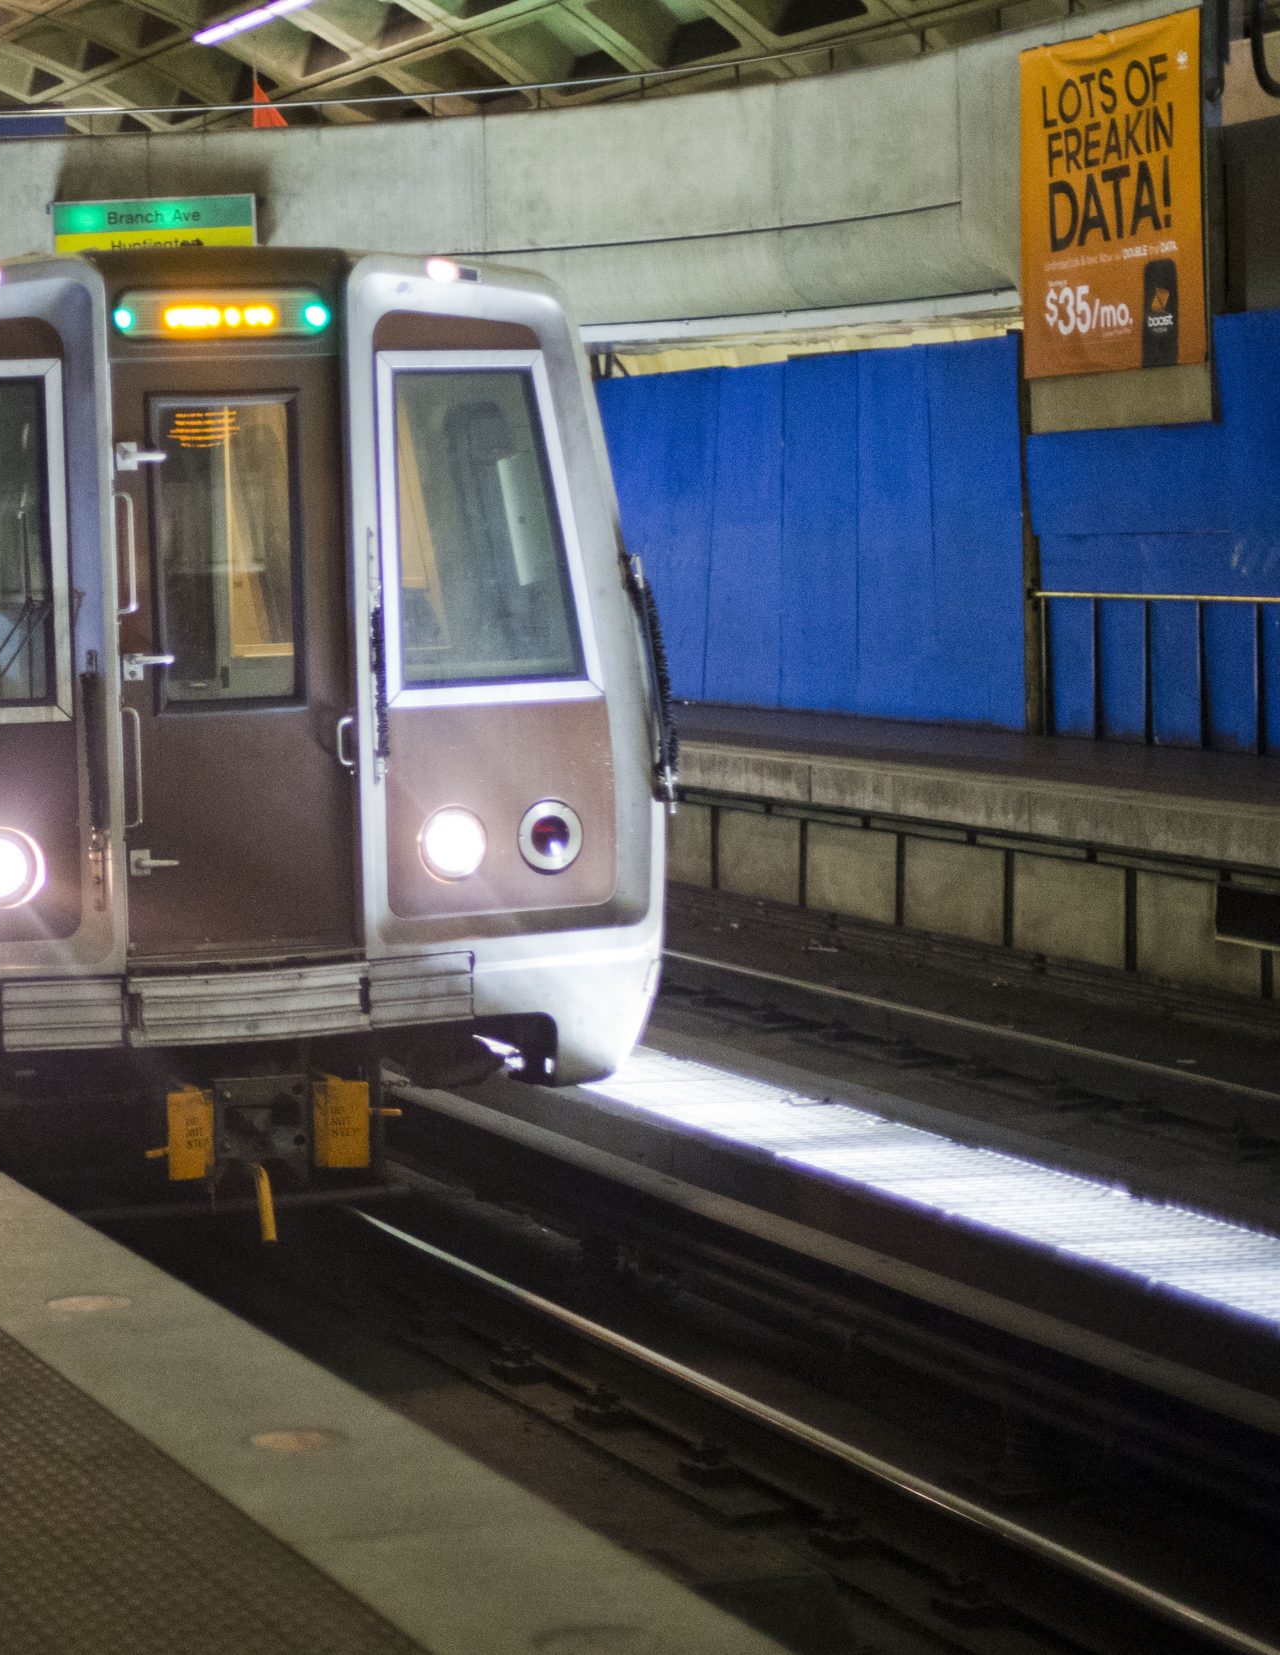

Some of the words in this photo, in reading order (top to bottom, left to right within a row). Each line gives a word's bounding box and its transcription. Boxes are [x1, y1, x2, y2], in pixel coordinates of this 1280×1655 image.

[1041, 68, 1118, 130] LOTS
[1124, 53, 1169, 107] OF
[1047, 102, 1175, 178] FREAKIN
[107, 210, 163, 225] Branch
[172, 209, 201, 222] Ave
[1048, 155, 1173, 254] DATA!
[1045, 284, 1134, 336] $35/mo.
[1148, 313, 1174, 328] boost
